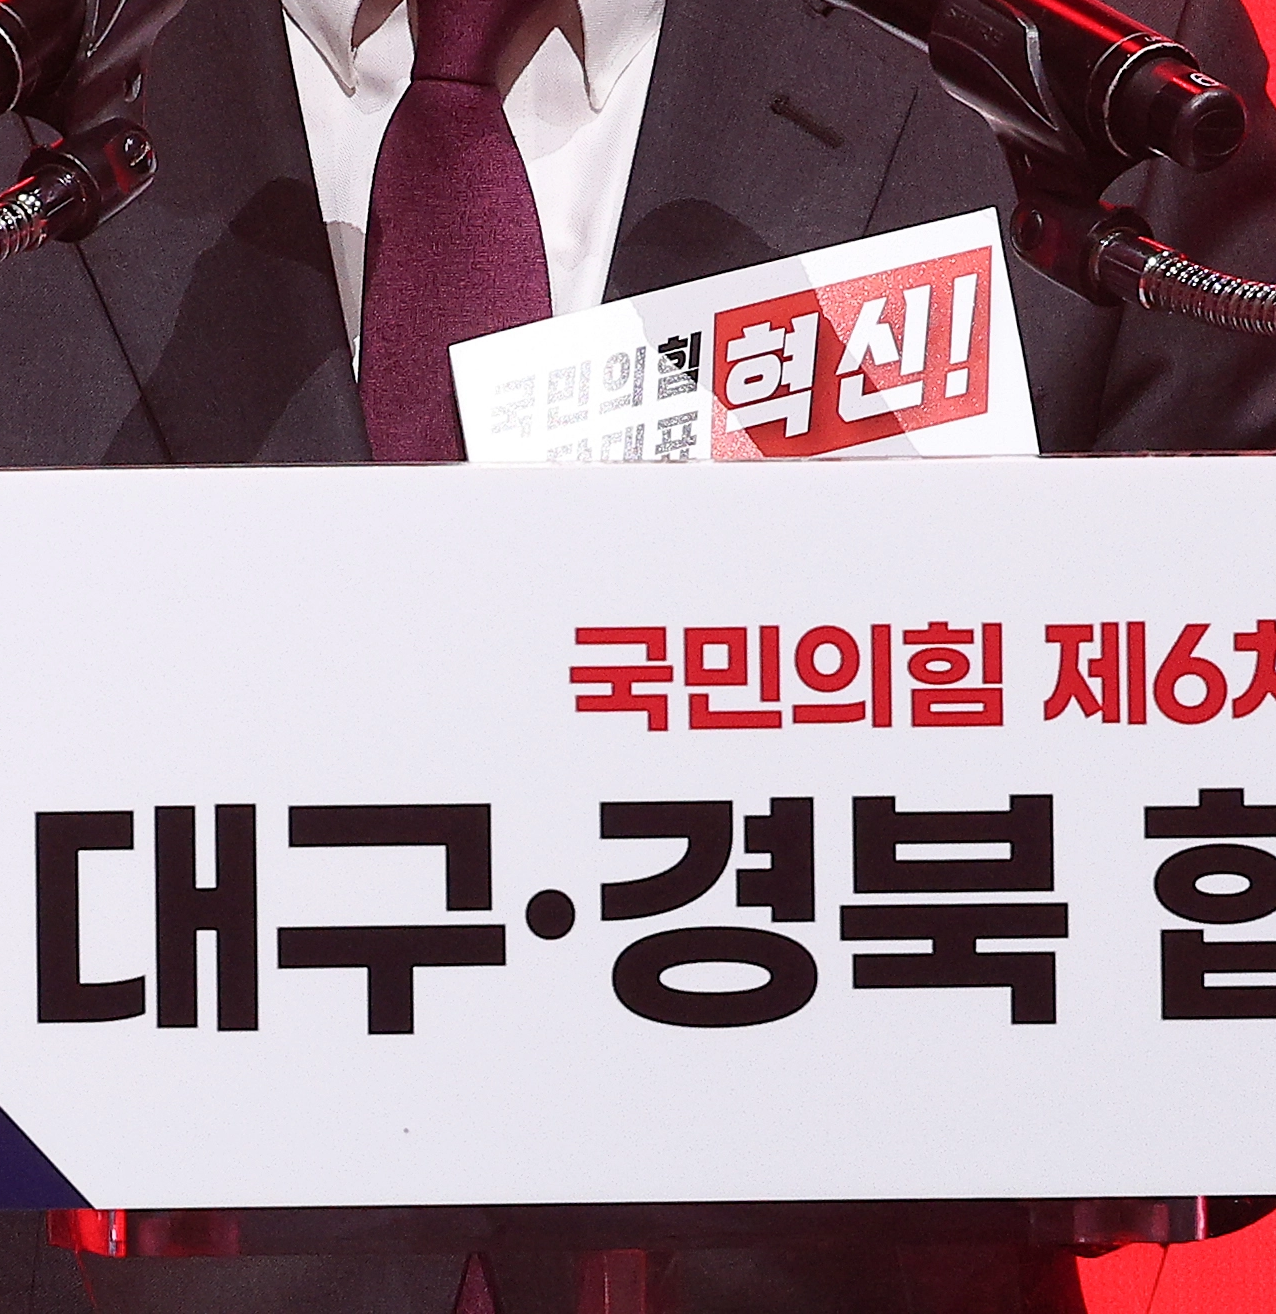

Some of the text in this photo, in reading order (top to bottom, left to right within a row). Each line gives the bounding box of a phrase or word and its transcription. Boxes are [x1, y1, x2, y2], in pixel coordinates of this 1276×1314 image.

[490, 331, 702, 438] 국민의힘
[725, 276, 978, 438] 혁신!
[571, 622, 1003, 731] 국민의힘
[35, 794, 1068, 1035] 대구·경북
